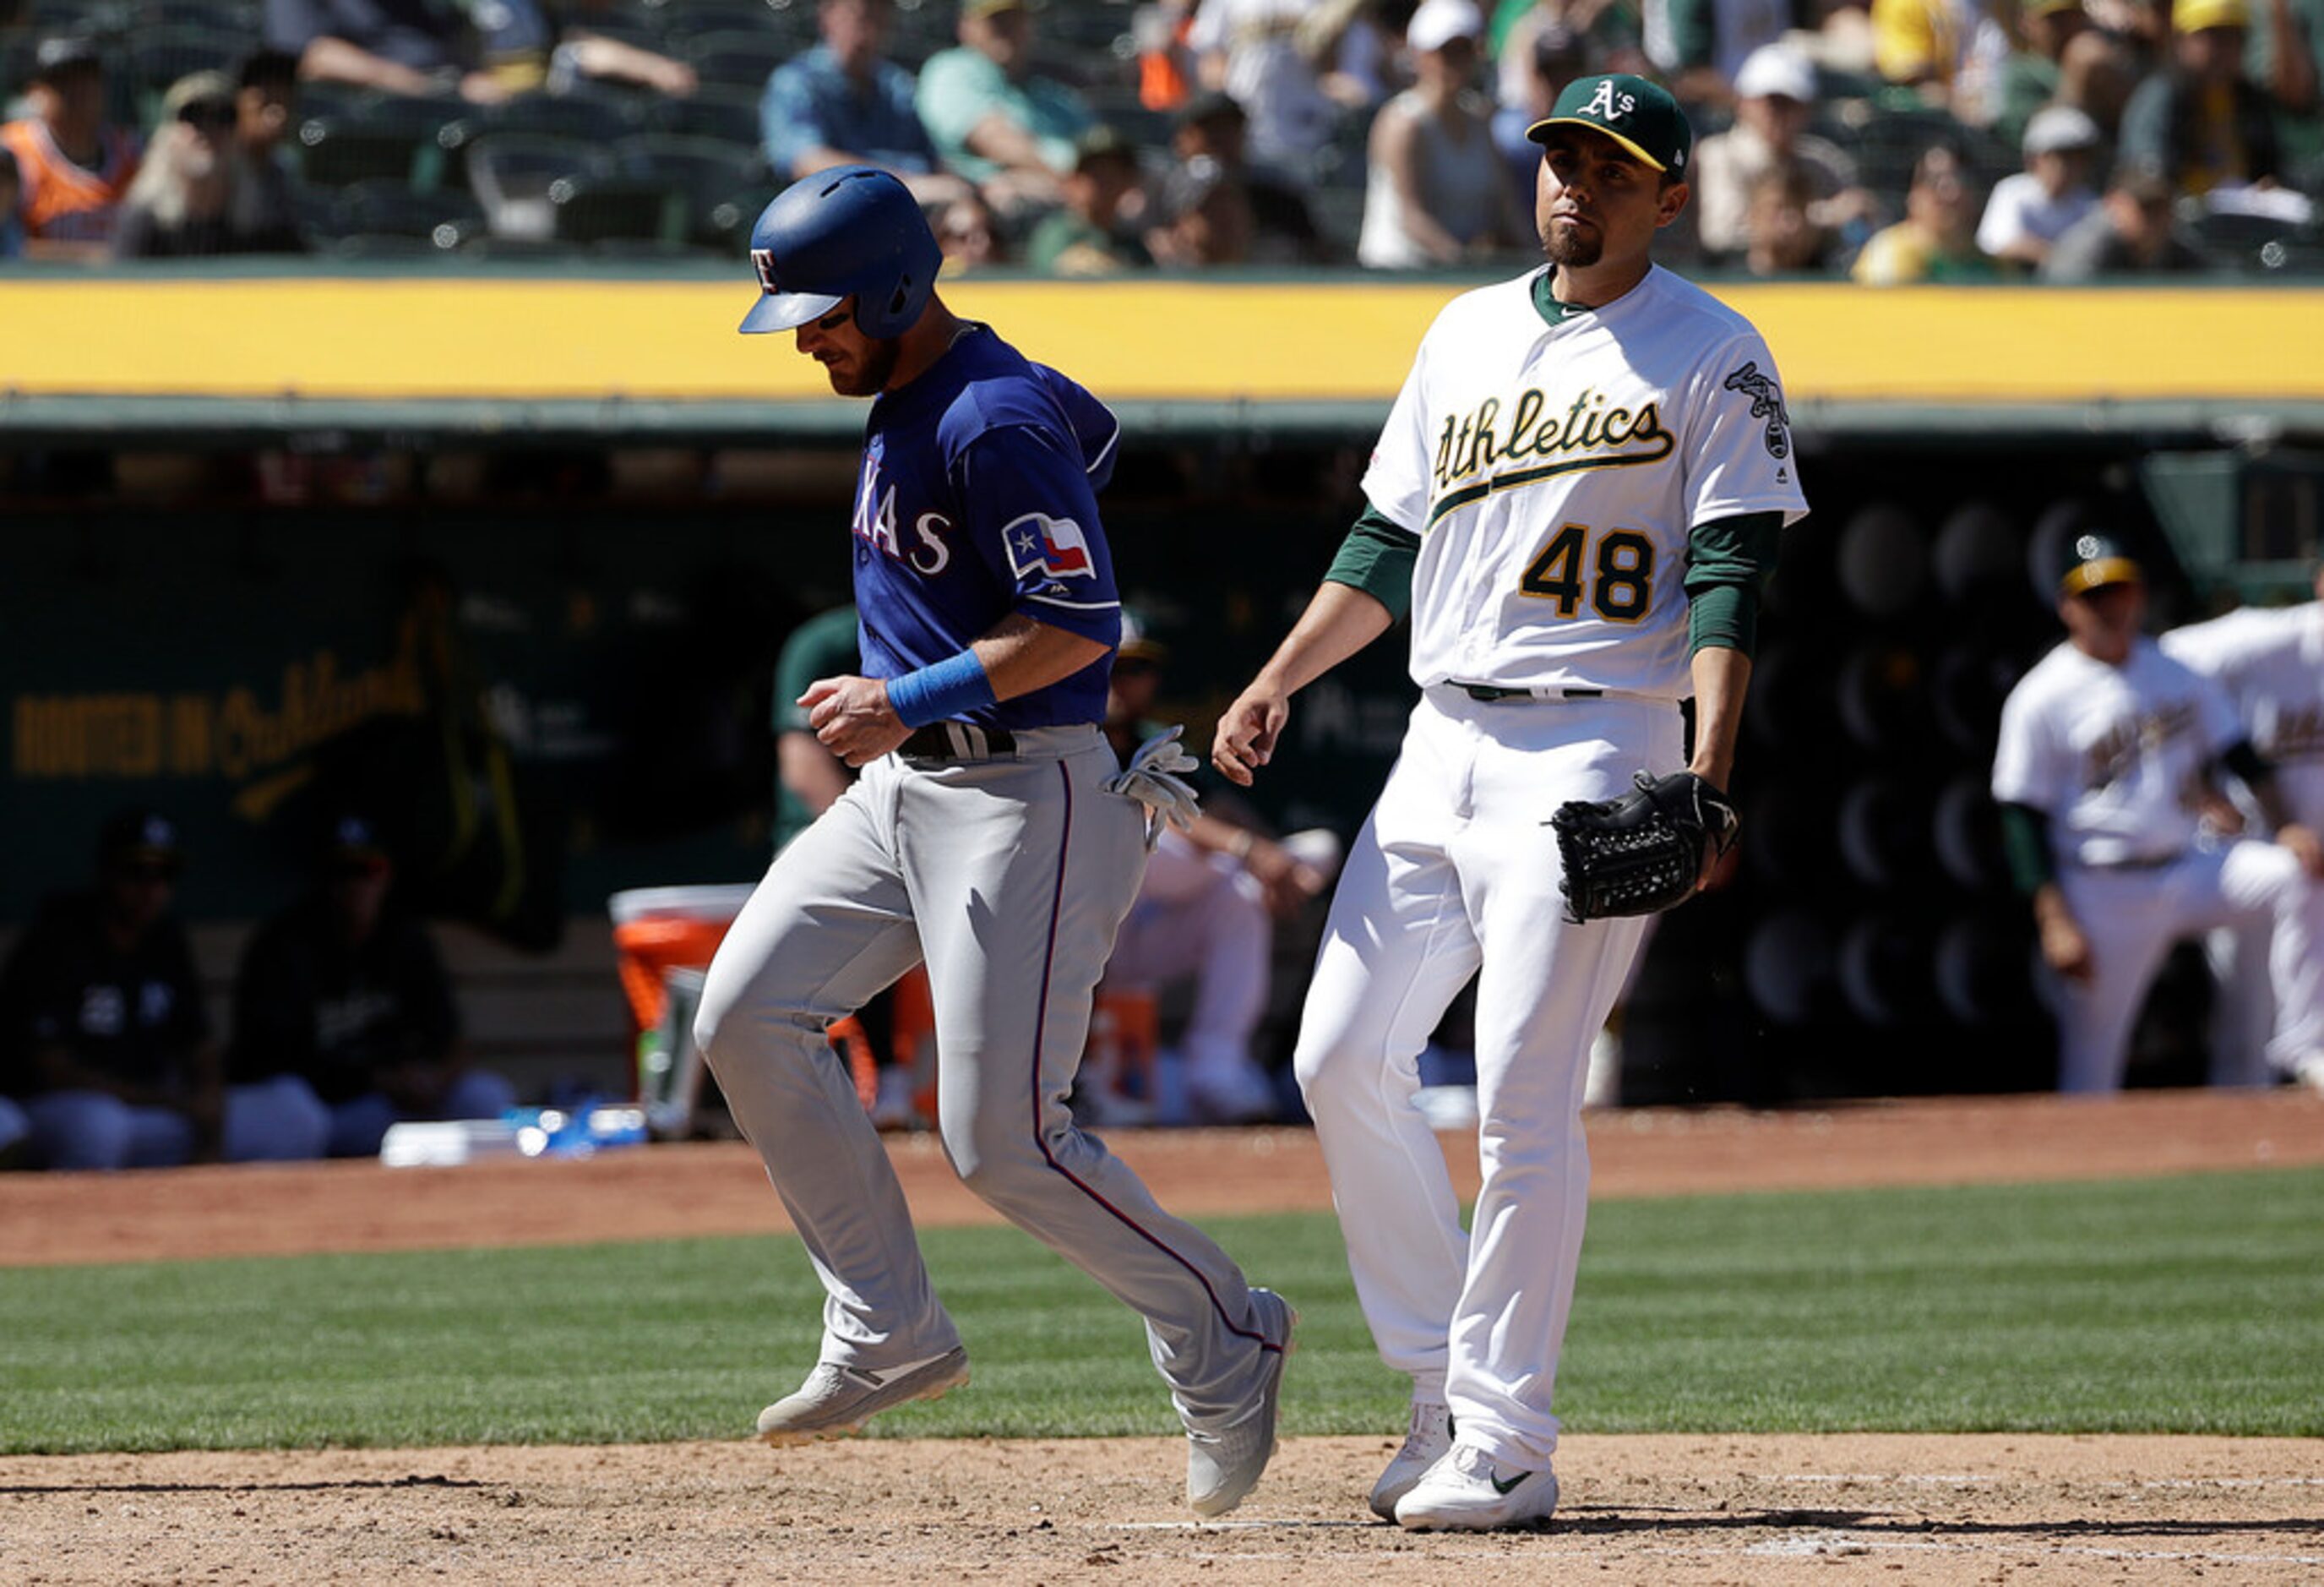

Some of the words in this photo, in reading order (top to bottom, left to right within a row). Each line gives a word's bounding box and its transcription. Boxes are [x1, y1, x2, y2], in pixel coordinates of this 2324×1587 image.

[1577, 79, 1636, 121] A's
[750, 248, 778, 294] T
[1430, 387, 1674, 497] Athletics
[852, 453, 952, 575] XAS
[1518, 522, 1656, 624] 48
